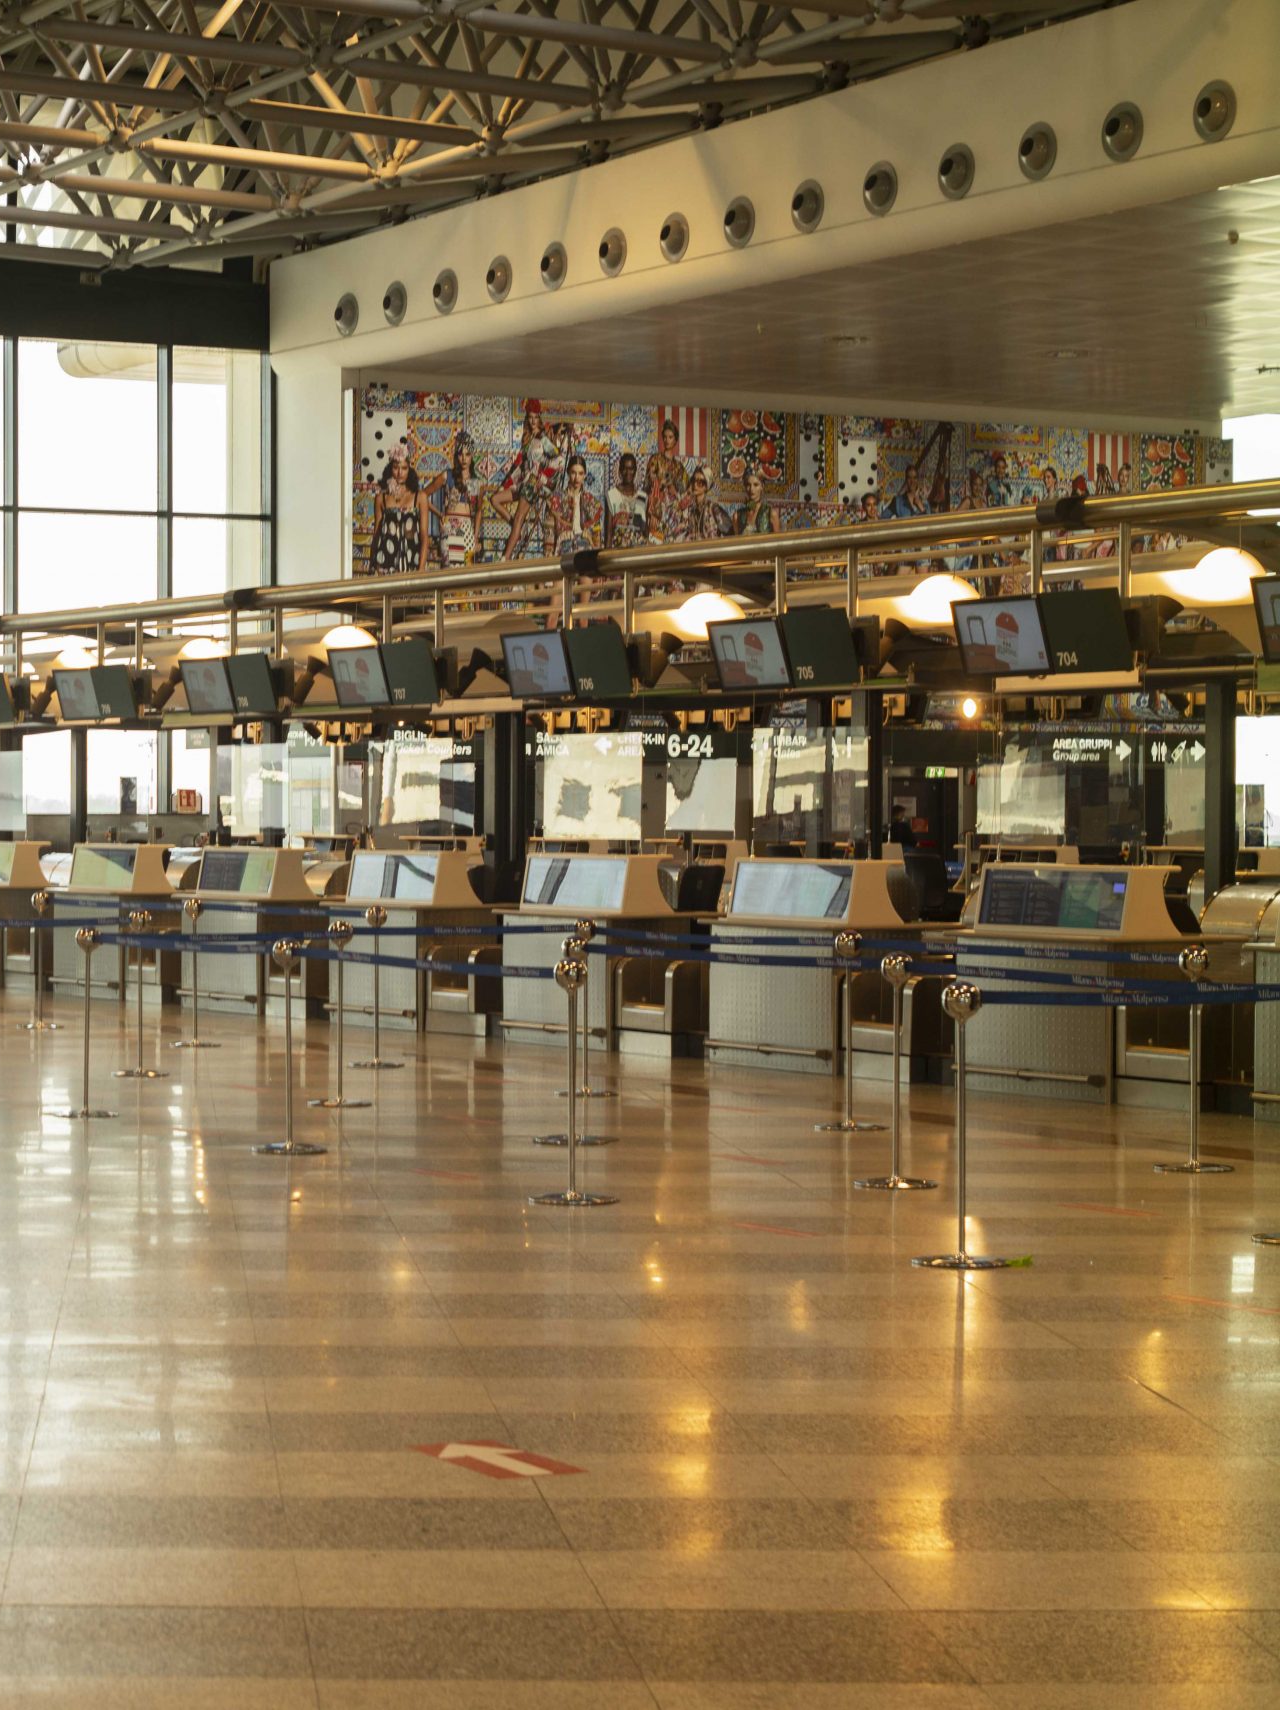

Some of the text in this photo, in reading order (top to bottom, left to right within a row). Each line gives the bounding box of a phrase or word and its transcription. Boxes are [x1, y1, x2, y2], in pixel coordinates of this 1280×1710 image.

[1056, 651, 1078, 667] 704
[797, 666, 814, 680] 705
[579, 678, 594, 691] 706
[667, 734, 714, 758] 6-24
[1052, 738, 1112, 750] AREA GRUPPI
[1052, 750, 1100, 763] Group area
[1072, 975, 1124, 988] Milano Malpensa
[1102, 993, 1168, 1006] Milano Malpensa
[1258, 988, 1280, 999] Milan
